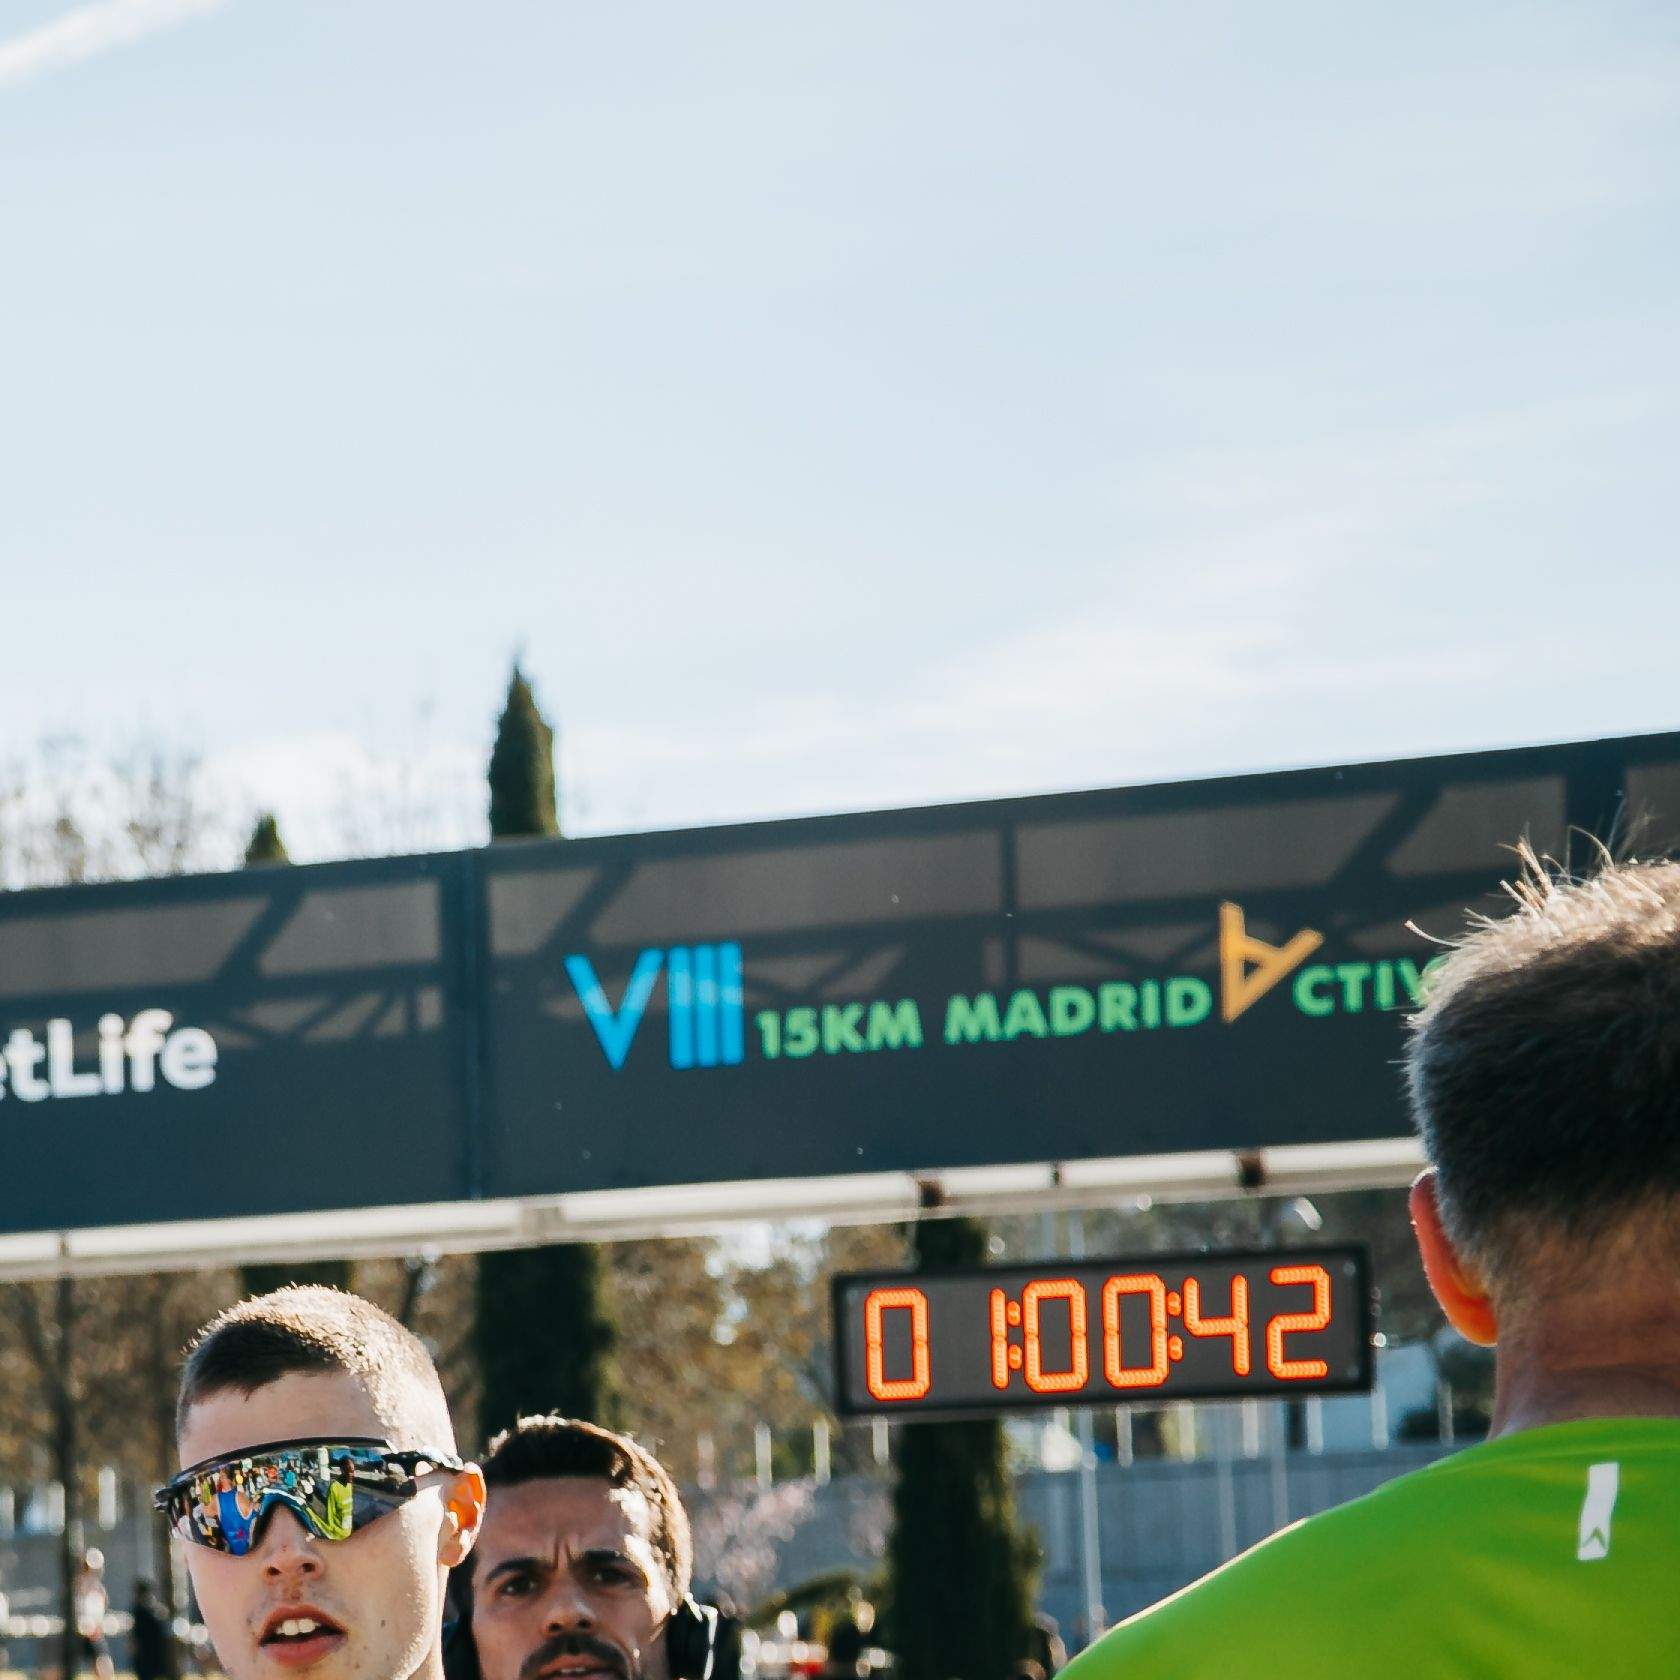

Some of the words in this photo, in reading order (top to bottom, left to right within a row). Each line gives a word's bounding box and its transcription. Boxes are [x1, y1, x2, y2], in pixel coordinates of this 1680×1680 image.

[563, 941, 744, 1071] VIII
[755, 998, 924, 1060] 15KM
[944, 976, 1214, 1046] MADRID
